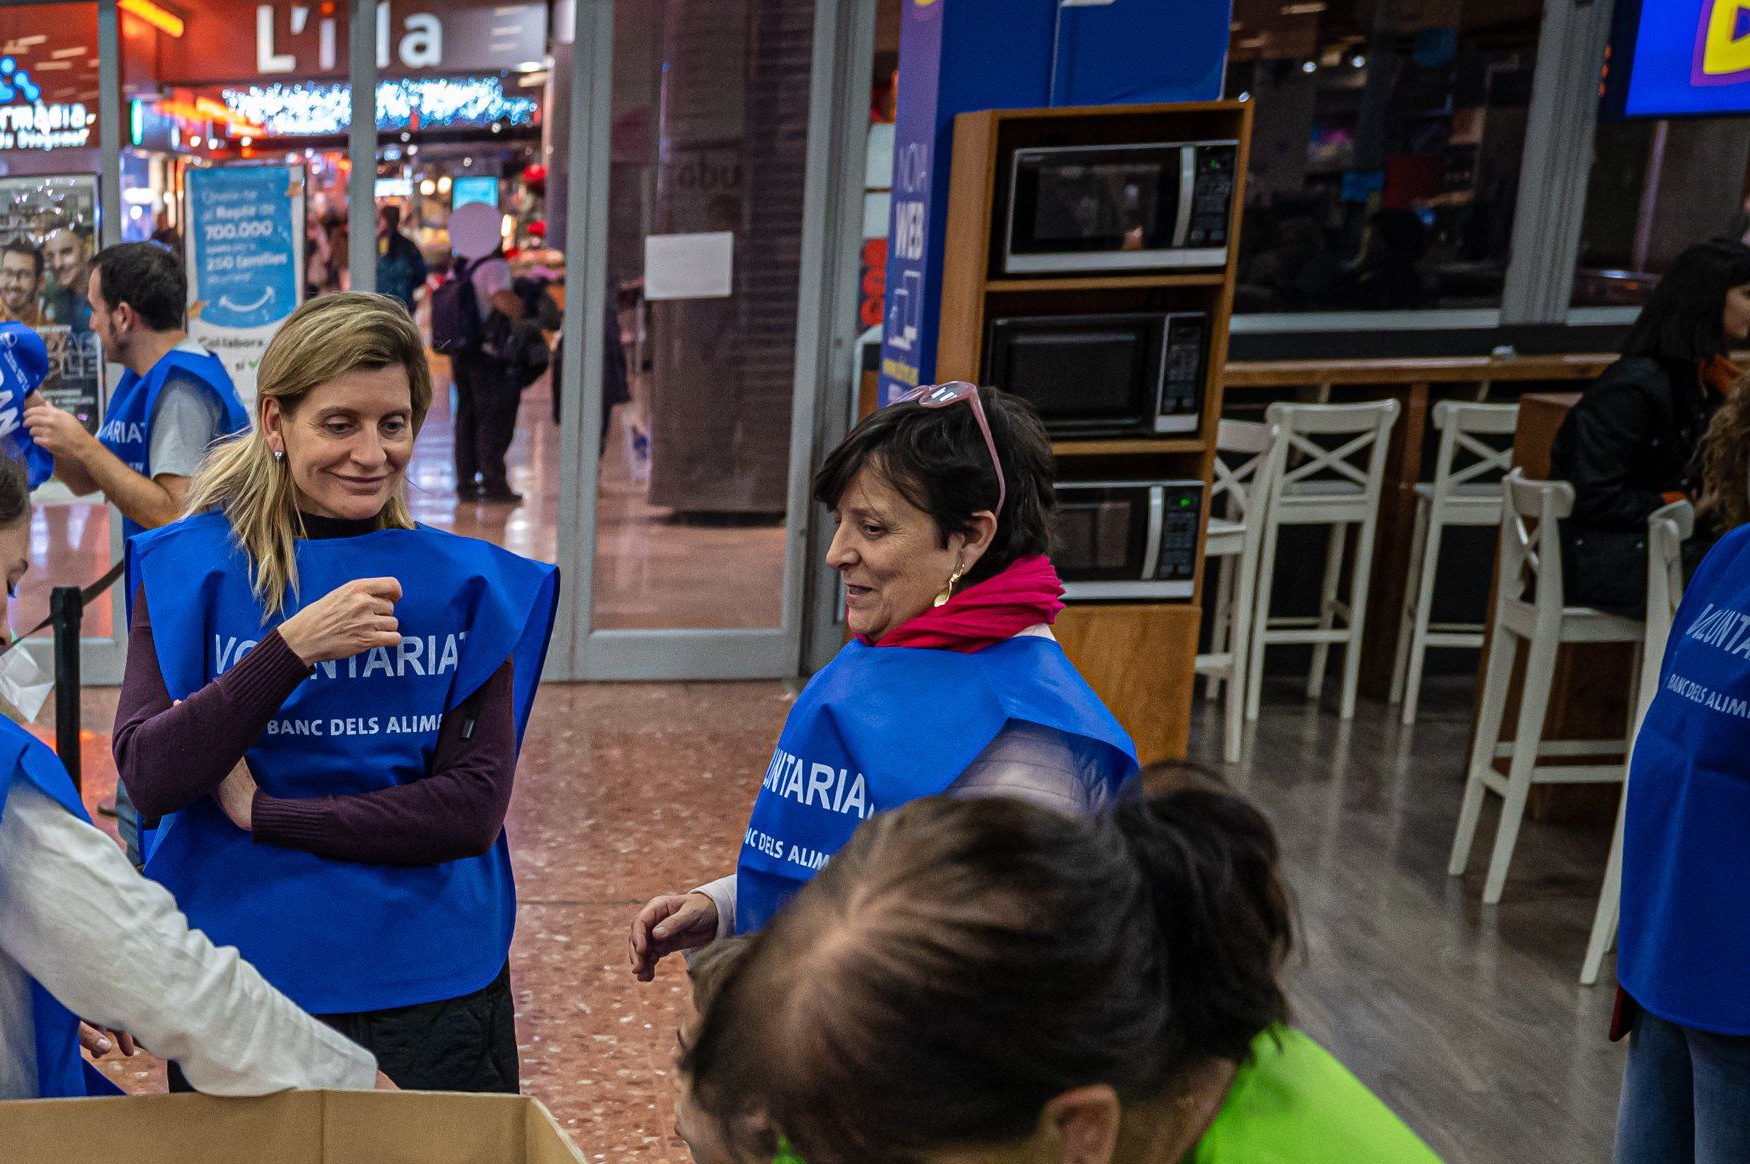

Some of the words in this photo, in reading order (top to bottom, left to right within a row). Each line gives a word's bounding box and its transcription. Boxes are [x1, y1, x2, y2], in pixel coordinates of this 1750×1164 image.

[256, 1, 443, 73] L'ila
[1685, 681, 1708, 703] DELS
[1705, 690, 1750, 719] ALIM
[267, 718, 323, 736] BANC
[330, 717, 380, 736] DELS
[386, 713, 443, 734] ALIM
[758, 832, 784, 859] DELS
[787, 845, 830, 871] ALIM
